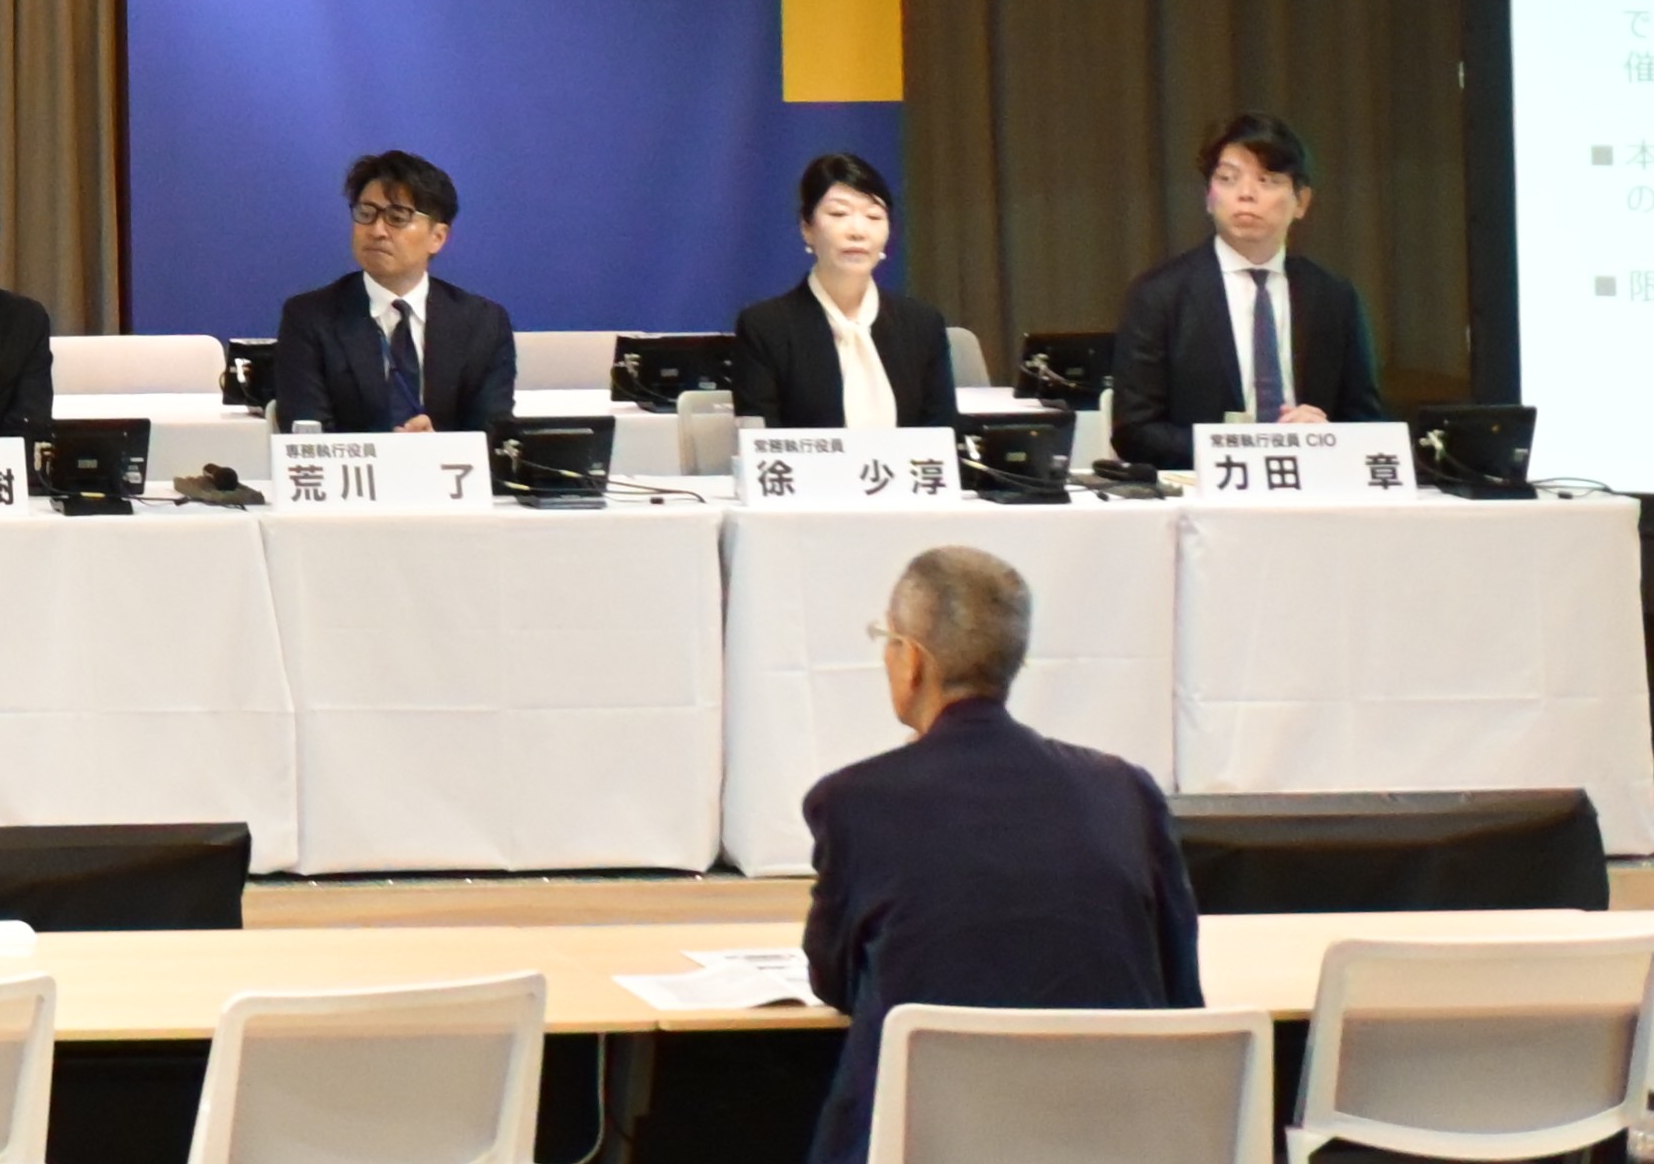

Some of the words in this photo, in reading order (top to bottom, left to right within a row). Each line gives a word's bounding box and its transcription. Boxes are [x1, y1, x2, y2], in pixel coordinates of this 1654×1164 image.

[1306, 432, 1337, 447] CIO
[285, 443, 377, 459] 専務執行役員
